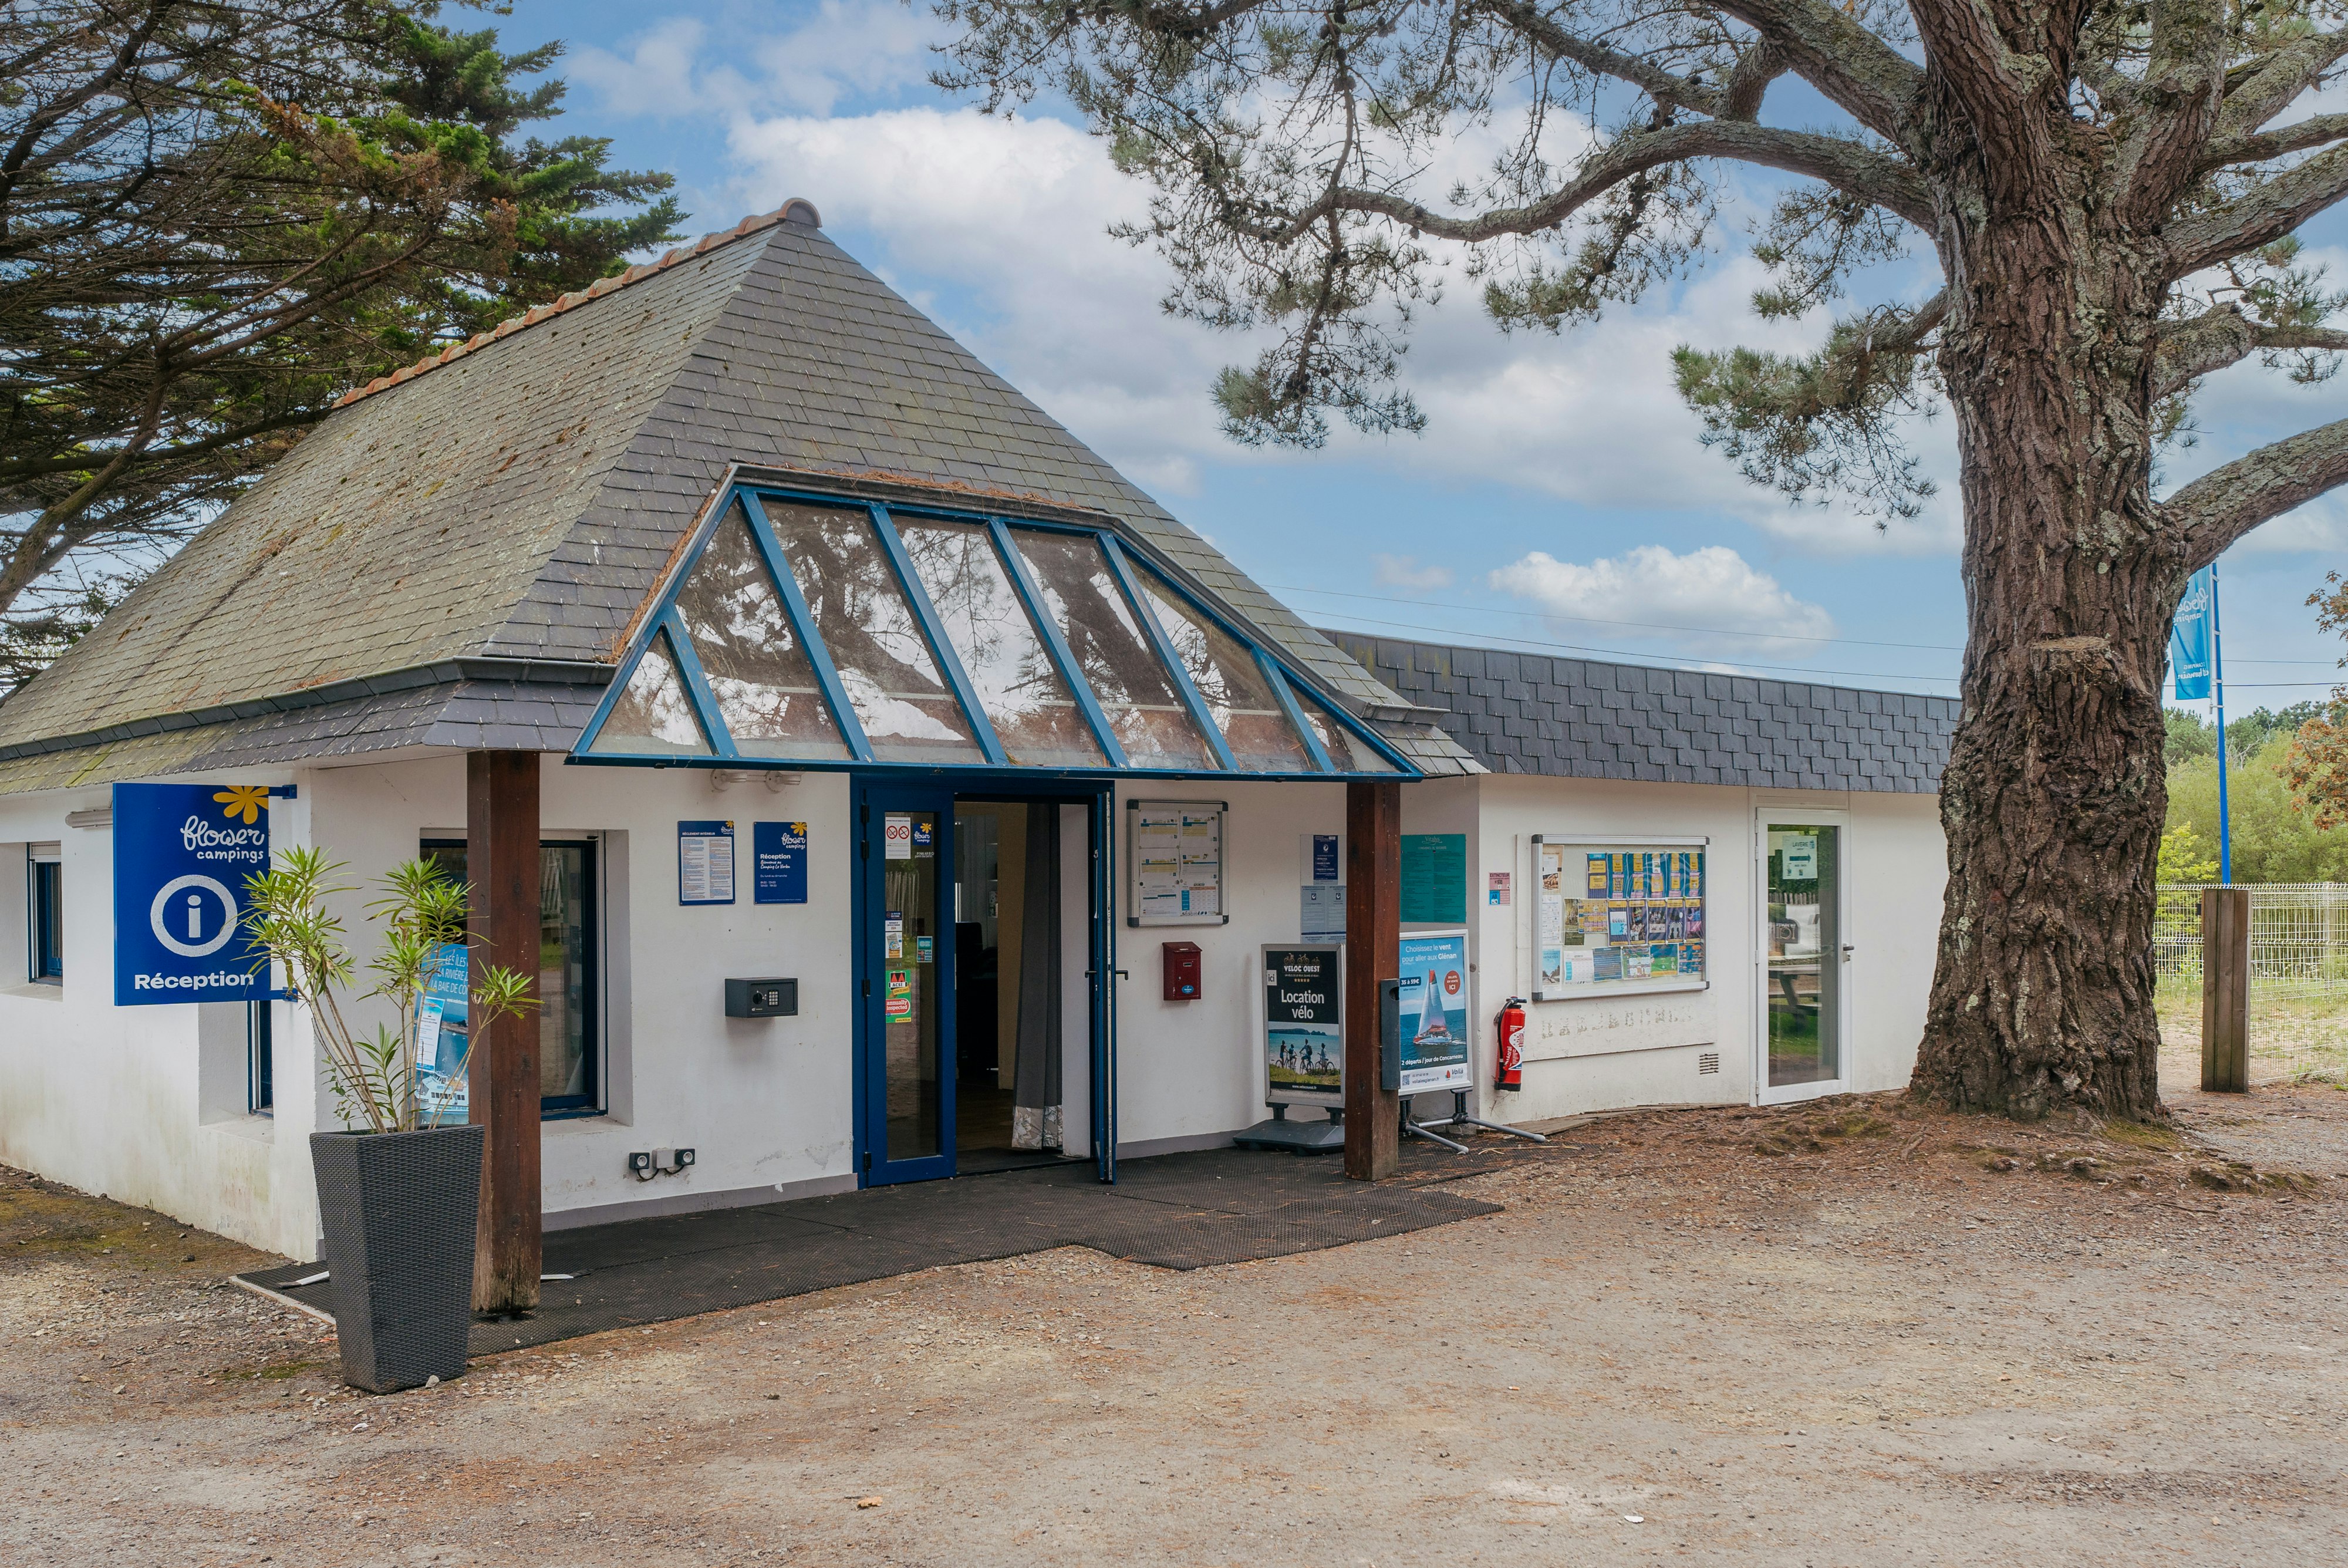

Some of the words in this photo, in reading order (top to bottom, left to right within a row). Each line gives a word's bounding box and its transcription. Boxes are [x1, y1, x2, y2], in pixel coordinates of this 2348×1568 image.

[180, 815, 265, 850] flower
[781, 832, 806, 845] flower
[914, 831, 930, 840] flower
[197, 847, 264, 863] campings
[1405, 945, 1433, 953] Choisissez
[455, 954, 467, 967] ÎLES
[134, 970, 254, 990] Réception
[444, 967, 465, 980] RIVIÈRE
[438, 981, 450, 992] BAIE
[450, 983, 458, 993] DE
[1281, 989, 1325, 1004] Location
[1291, 1005, 1314, 1019] vélo
